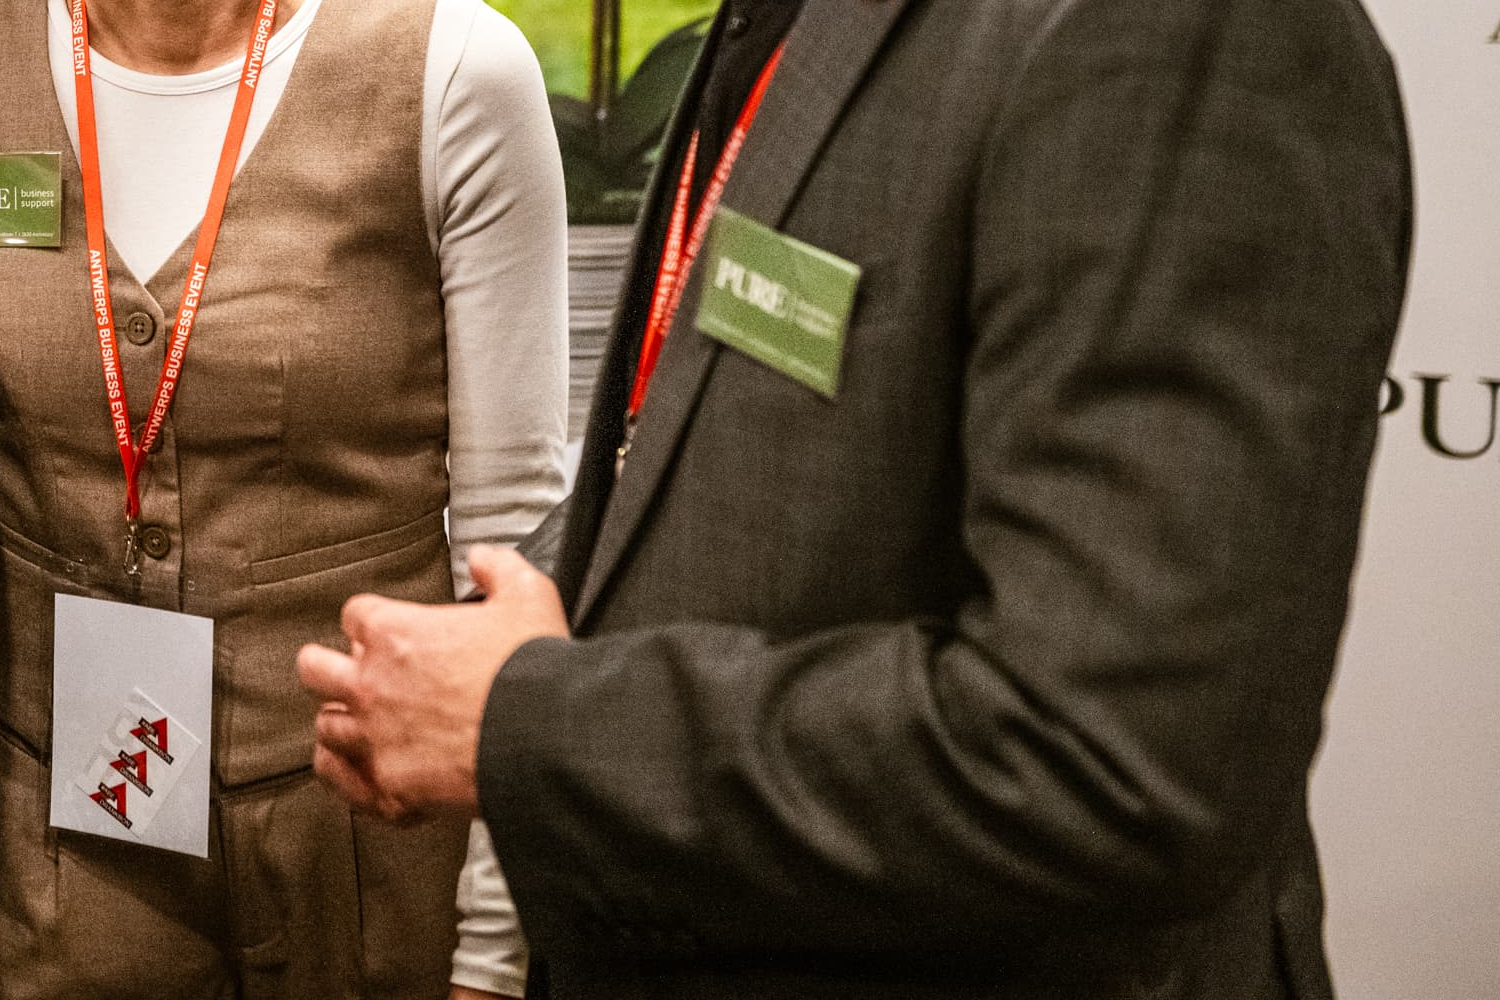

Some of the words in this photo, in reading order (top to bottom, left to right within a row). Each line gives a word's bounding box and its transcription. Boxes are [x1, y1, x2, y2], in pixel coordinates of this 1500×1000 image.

[73, 36, 86, 77] EVENT
[244, 18, 272, 88] ANTWERPS
[20, 189, 54, 198] business
[20, 199, 54, 209] support
[89, 249, 109, 326] ANTWERPS
[100, 328, 121, 400] BUSINESS
[141, 380, 174, 453] ANTWERPS
[165, 308, 194, 379] BUSINESS
[184, 261, 207, 308] EVENT
[110, 401, 129, 447] EVENT
